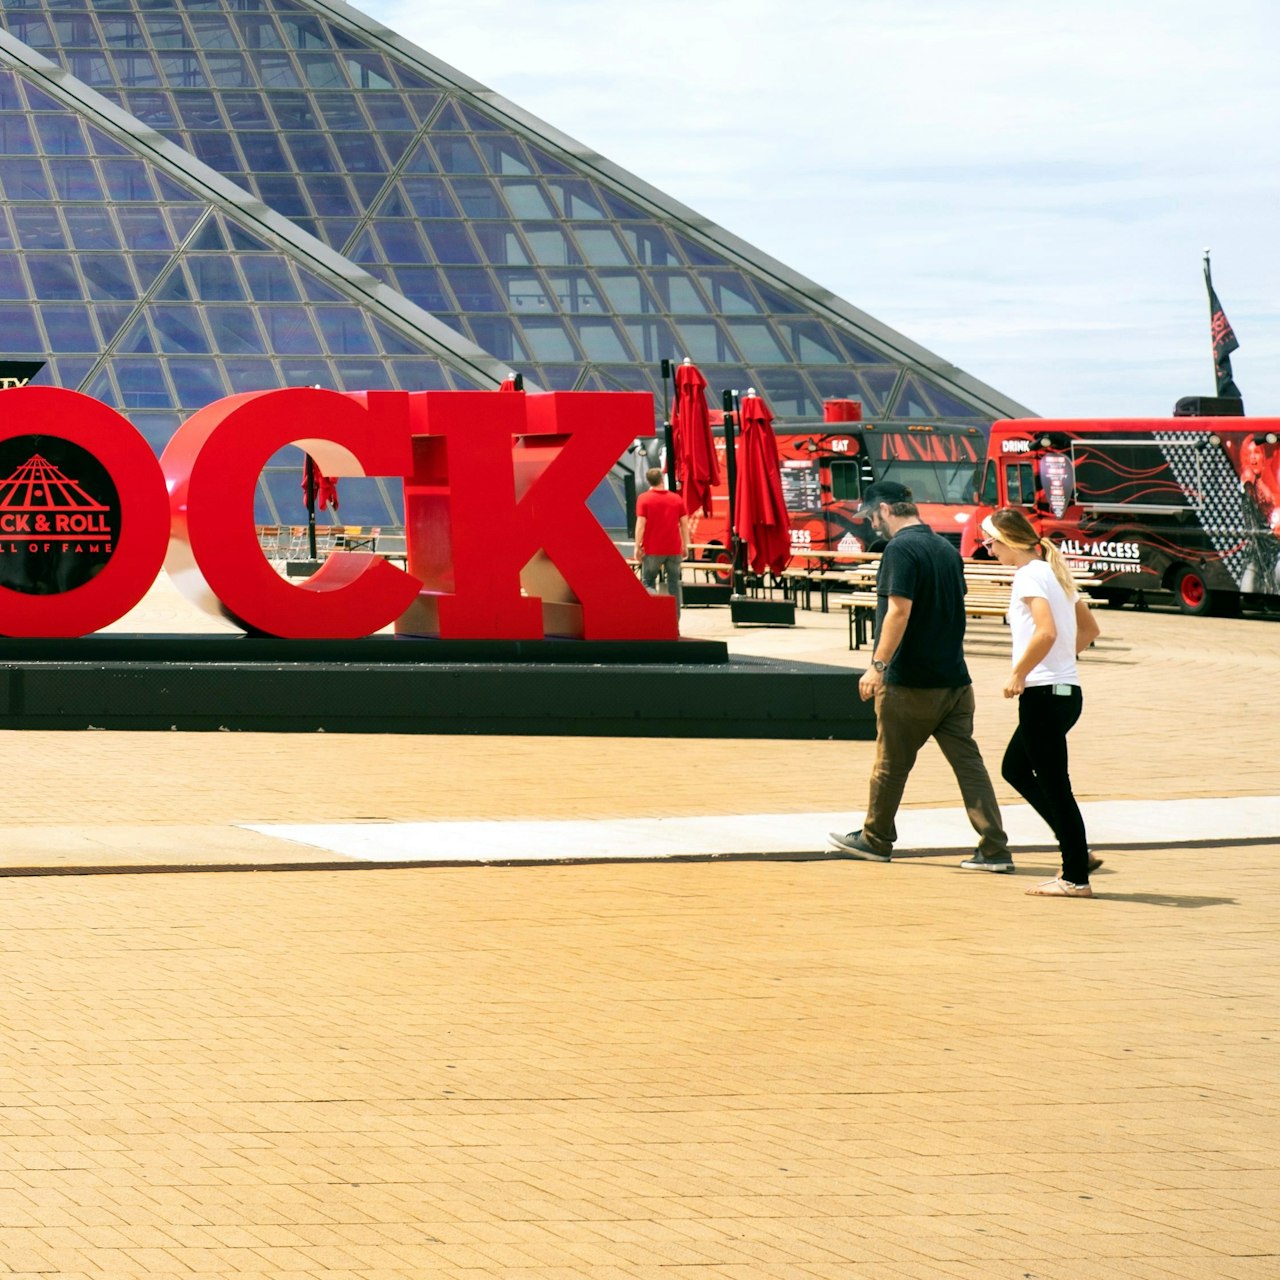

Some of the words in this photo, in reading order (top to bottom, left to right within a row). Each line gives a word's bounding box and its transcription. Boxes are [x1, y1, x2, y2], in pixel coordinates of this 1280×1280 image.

[0, 377, 30, 389] TV
[831, 439, 849, 452] EAT
[1002, 440, 1030, 453] DRINK
[34, 514, 51, 532] &
[56, 514, 111, 532] ROLL
[28, 543, 50, 553] OF
[62, 543, 112, 553] FAME
[1060, 540, 1083, 555] ALL
[1091, 541, 1140, 559] ACCESS
[1091, 561, 1109, 571] AND
[1110, 562, 1142, 573] EVENTS
